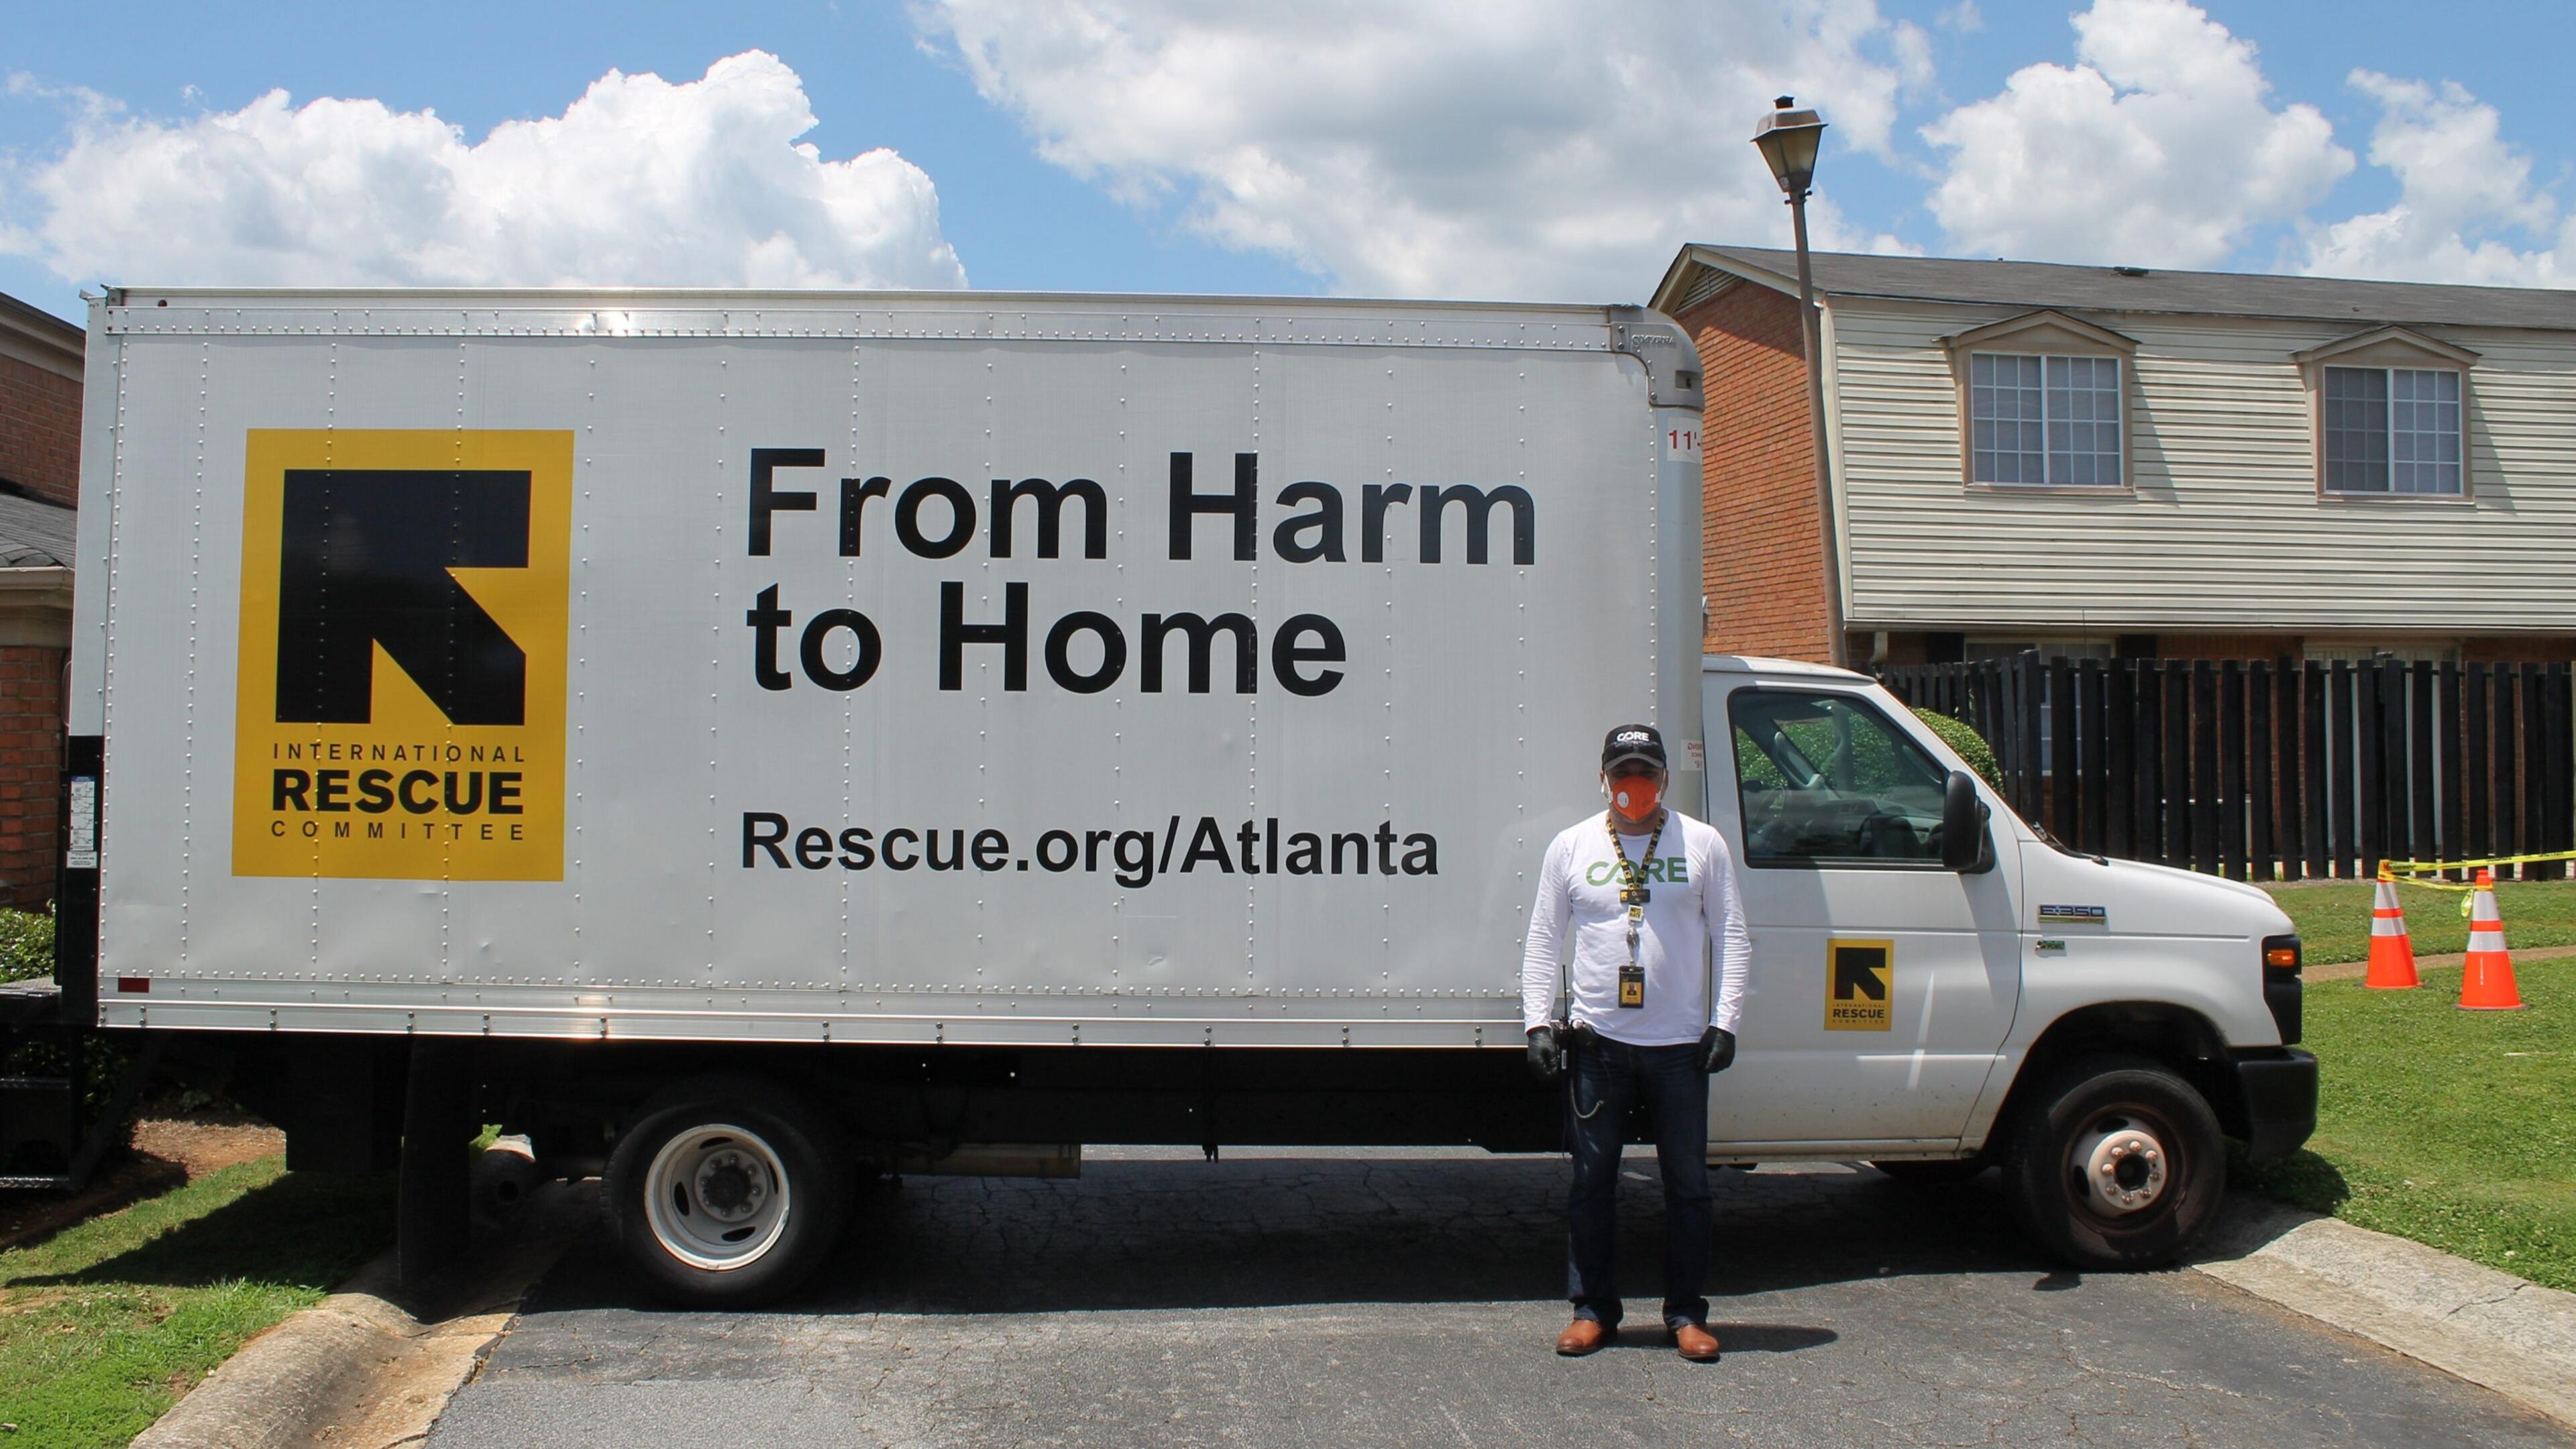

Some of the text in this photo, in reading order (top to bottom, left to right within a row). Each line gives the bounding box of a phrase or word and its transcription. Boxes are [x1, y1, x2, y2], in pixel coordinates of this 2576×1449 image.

[747, 447, 1536, 566] From Harm
[746, 581, 1346, 697] to Home
[1617, 731, 1650, 742] CORE
[273, 742, 525, 763] INTERNATIONAL
[272, 768, 524, 815] RESCUE
[270, 819, 524, 841] COMMITTEE
[742, 811, 1439, 889] Rescue.org/Atlanta
[1586, 857, 1689, 887] CORE
[1832, 1008, 1885, 1019] RESCUE
